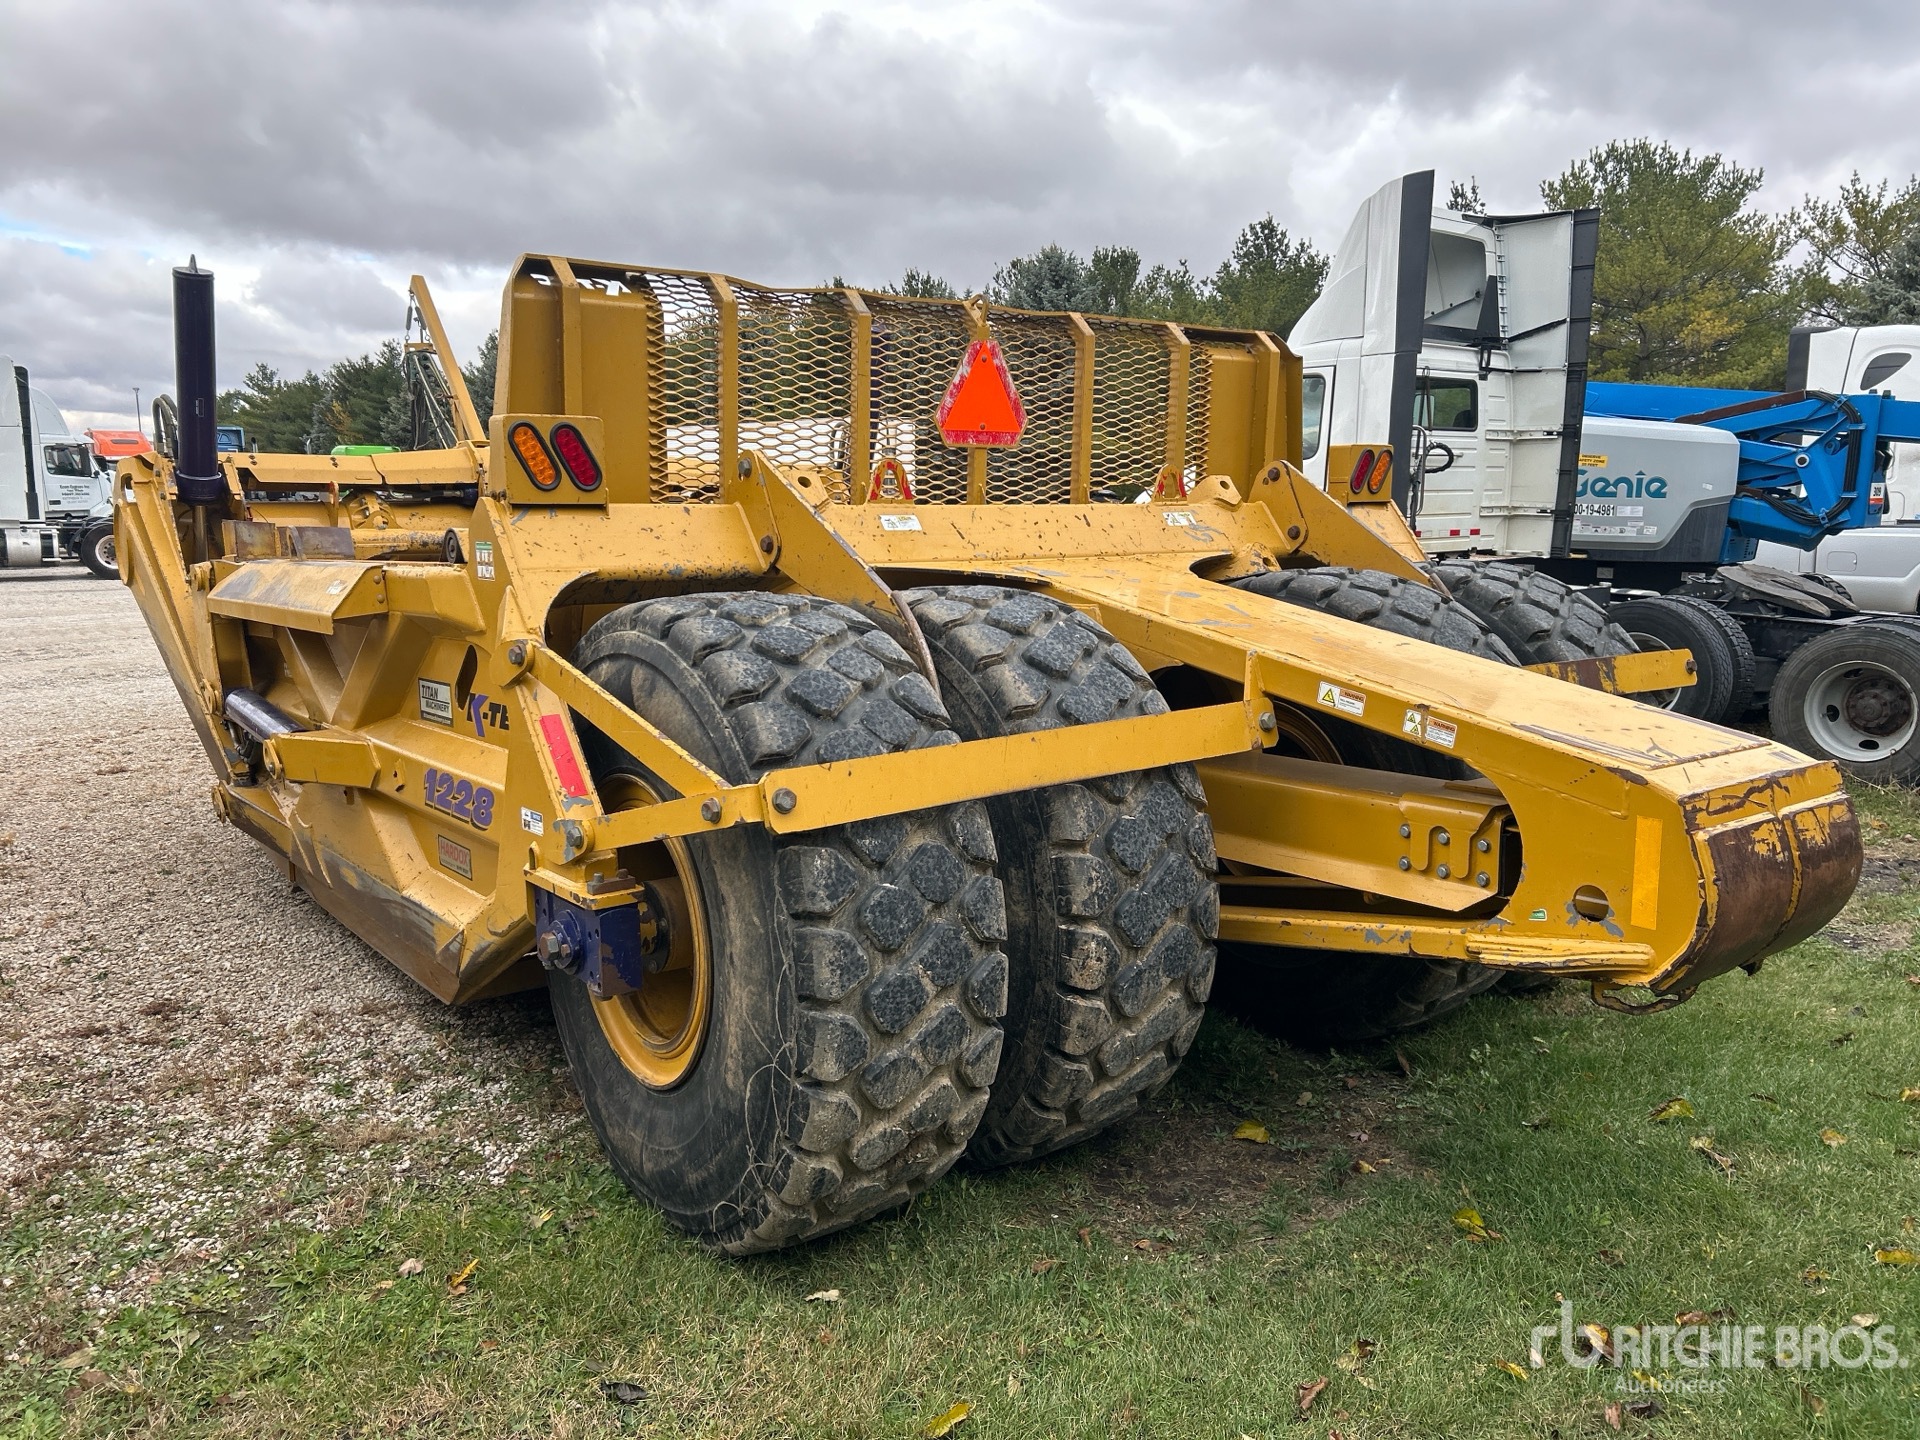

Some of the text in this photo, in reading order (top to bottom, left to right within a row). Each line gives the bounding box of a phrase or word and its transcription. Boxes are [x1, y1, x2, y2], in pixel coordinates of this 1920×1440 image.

[1576, 469, 1668, 499] Genie
[421, 684, 439, 700] TITAN
[425, 699, 450, 714] MACHINERY
[423, 767, 495, 831] 1228
[440, 839, 469, 867] HARDOX
